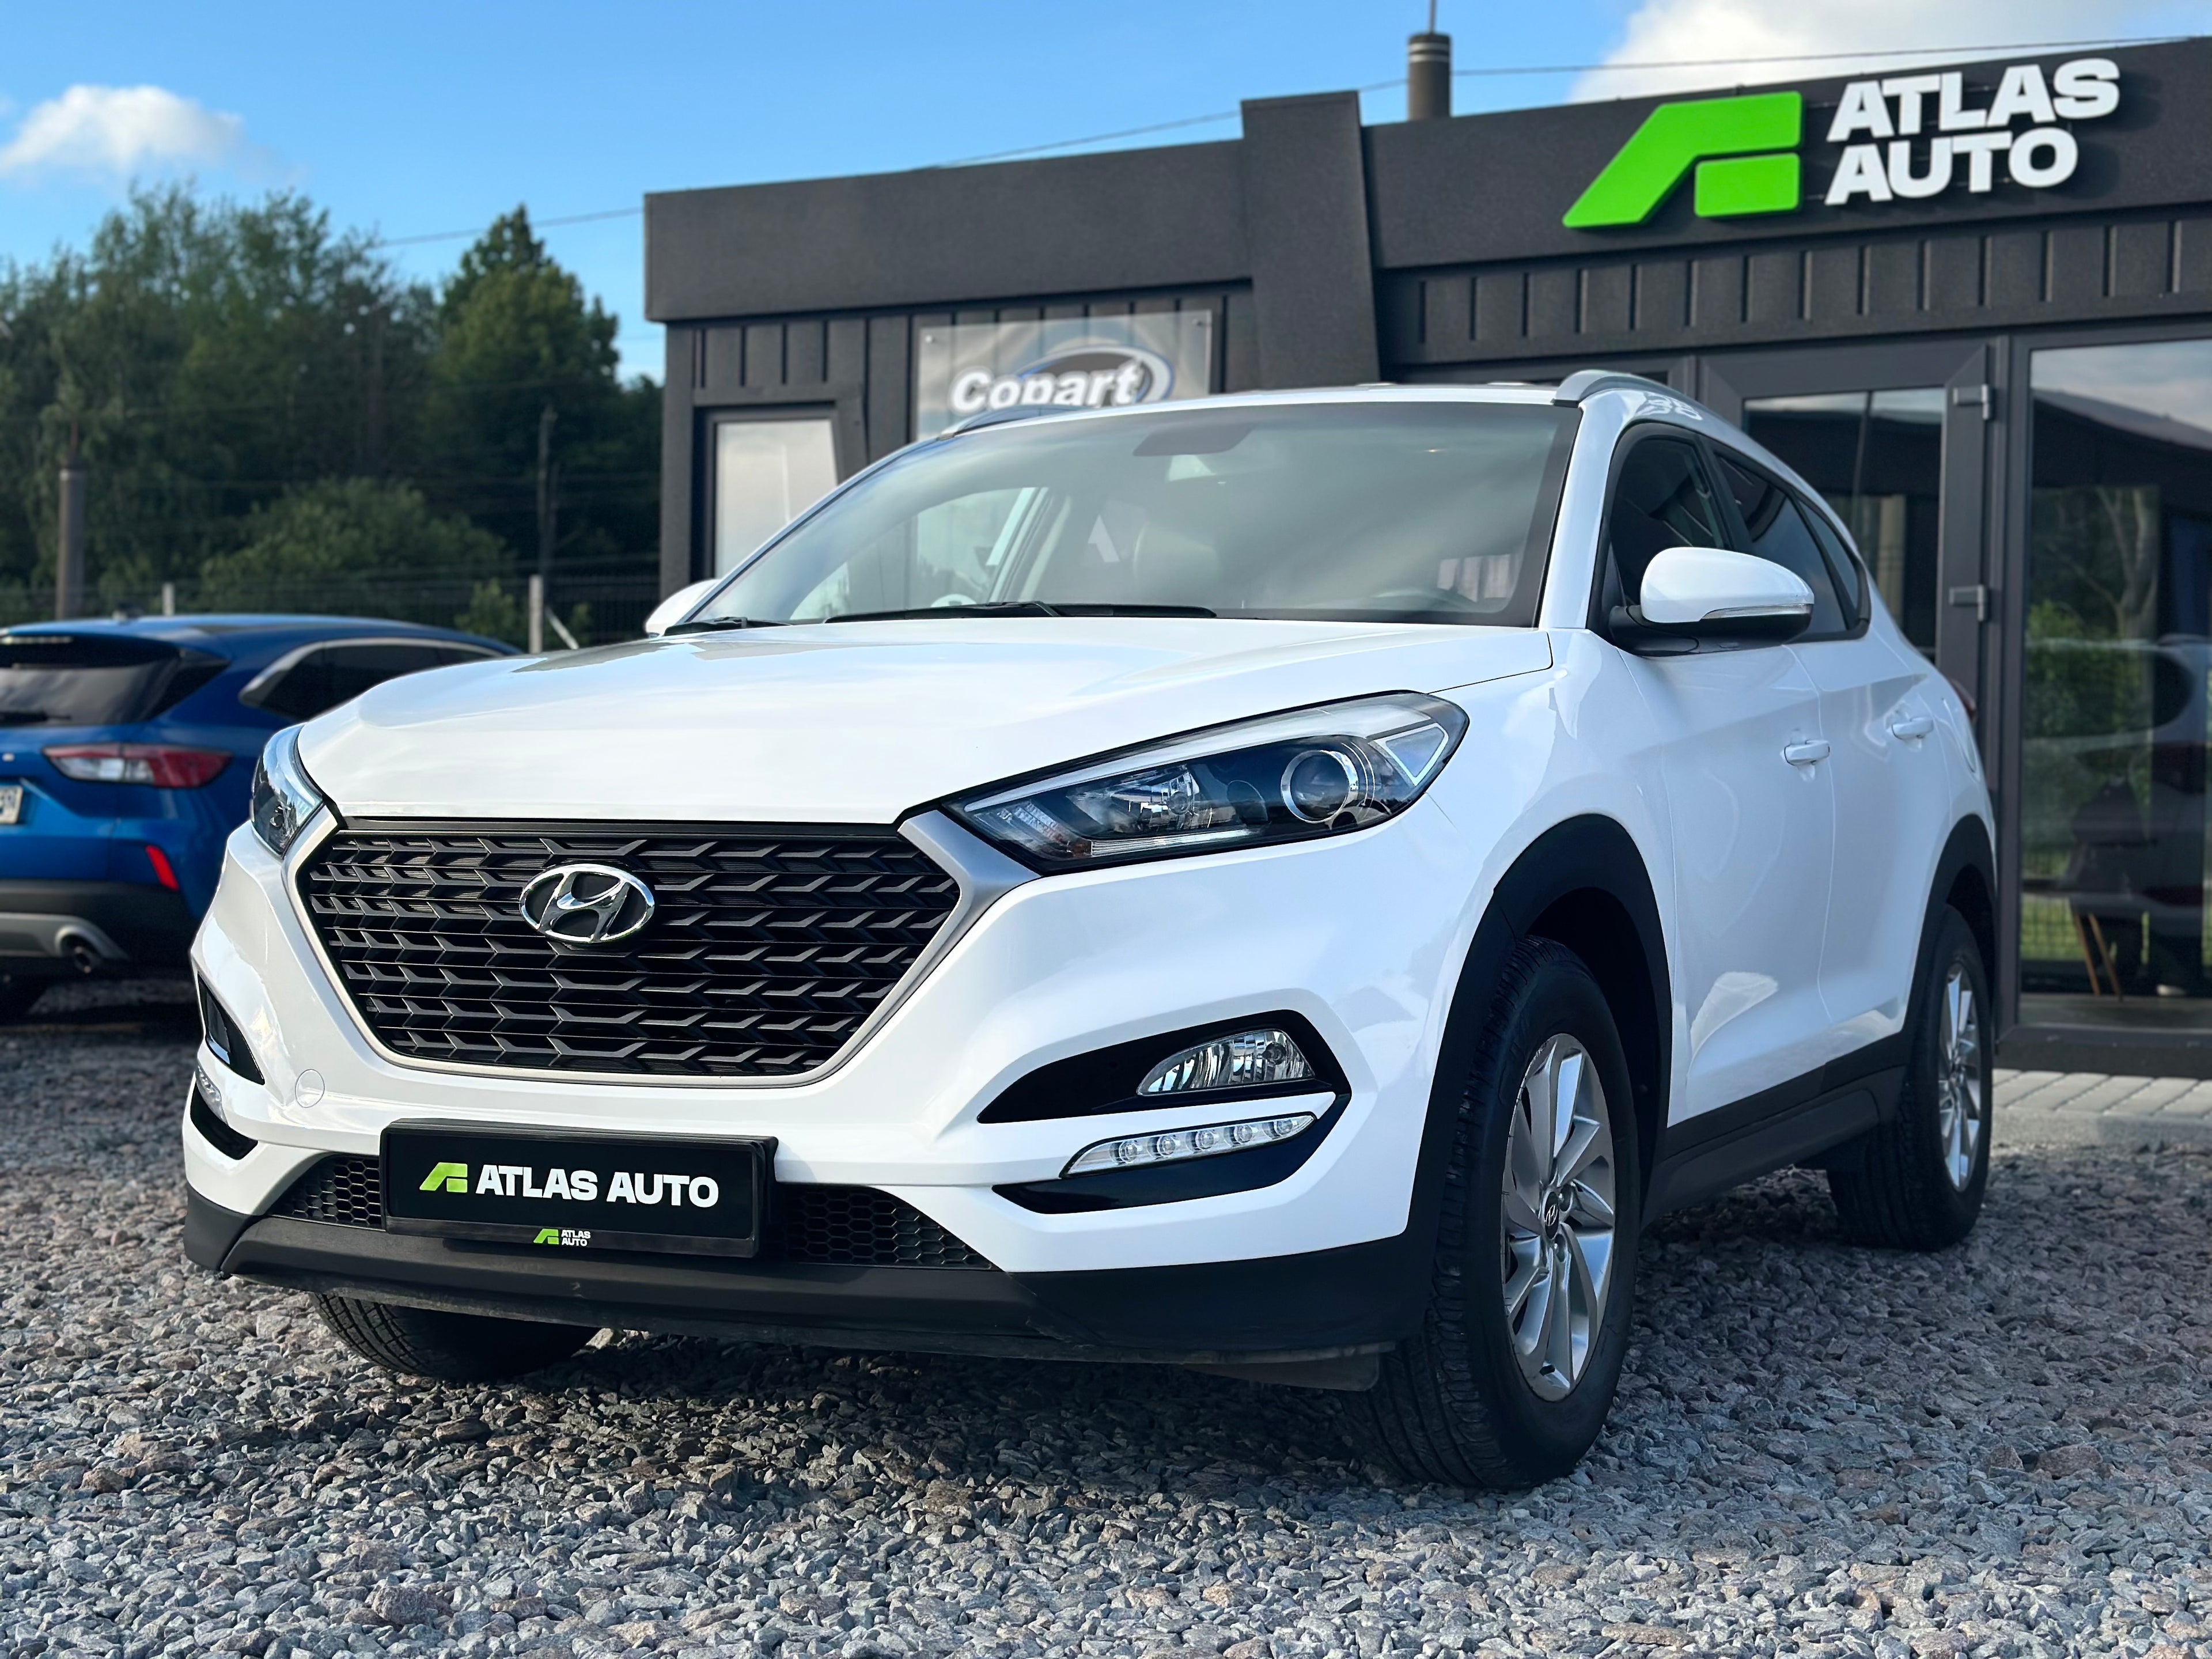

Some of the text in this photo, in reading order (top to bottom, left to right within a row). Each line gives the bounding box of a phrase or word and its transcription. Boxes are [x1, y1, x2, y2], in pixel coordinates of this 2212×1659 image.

[1827, 58, 2120, 142] ATLAS
[1825, 127, 2078, 205] AUTO
[950, 358, 1142, 411] Copart
[475, 1164, 719, 1208] ATLAS AUTO
[561, 1229, 591, 1239] ATLAS
[561, 1237, 588, 1247] AUTO
